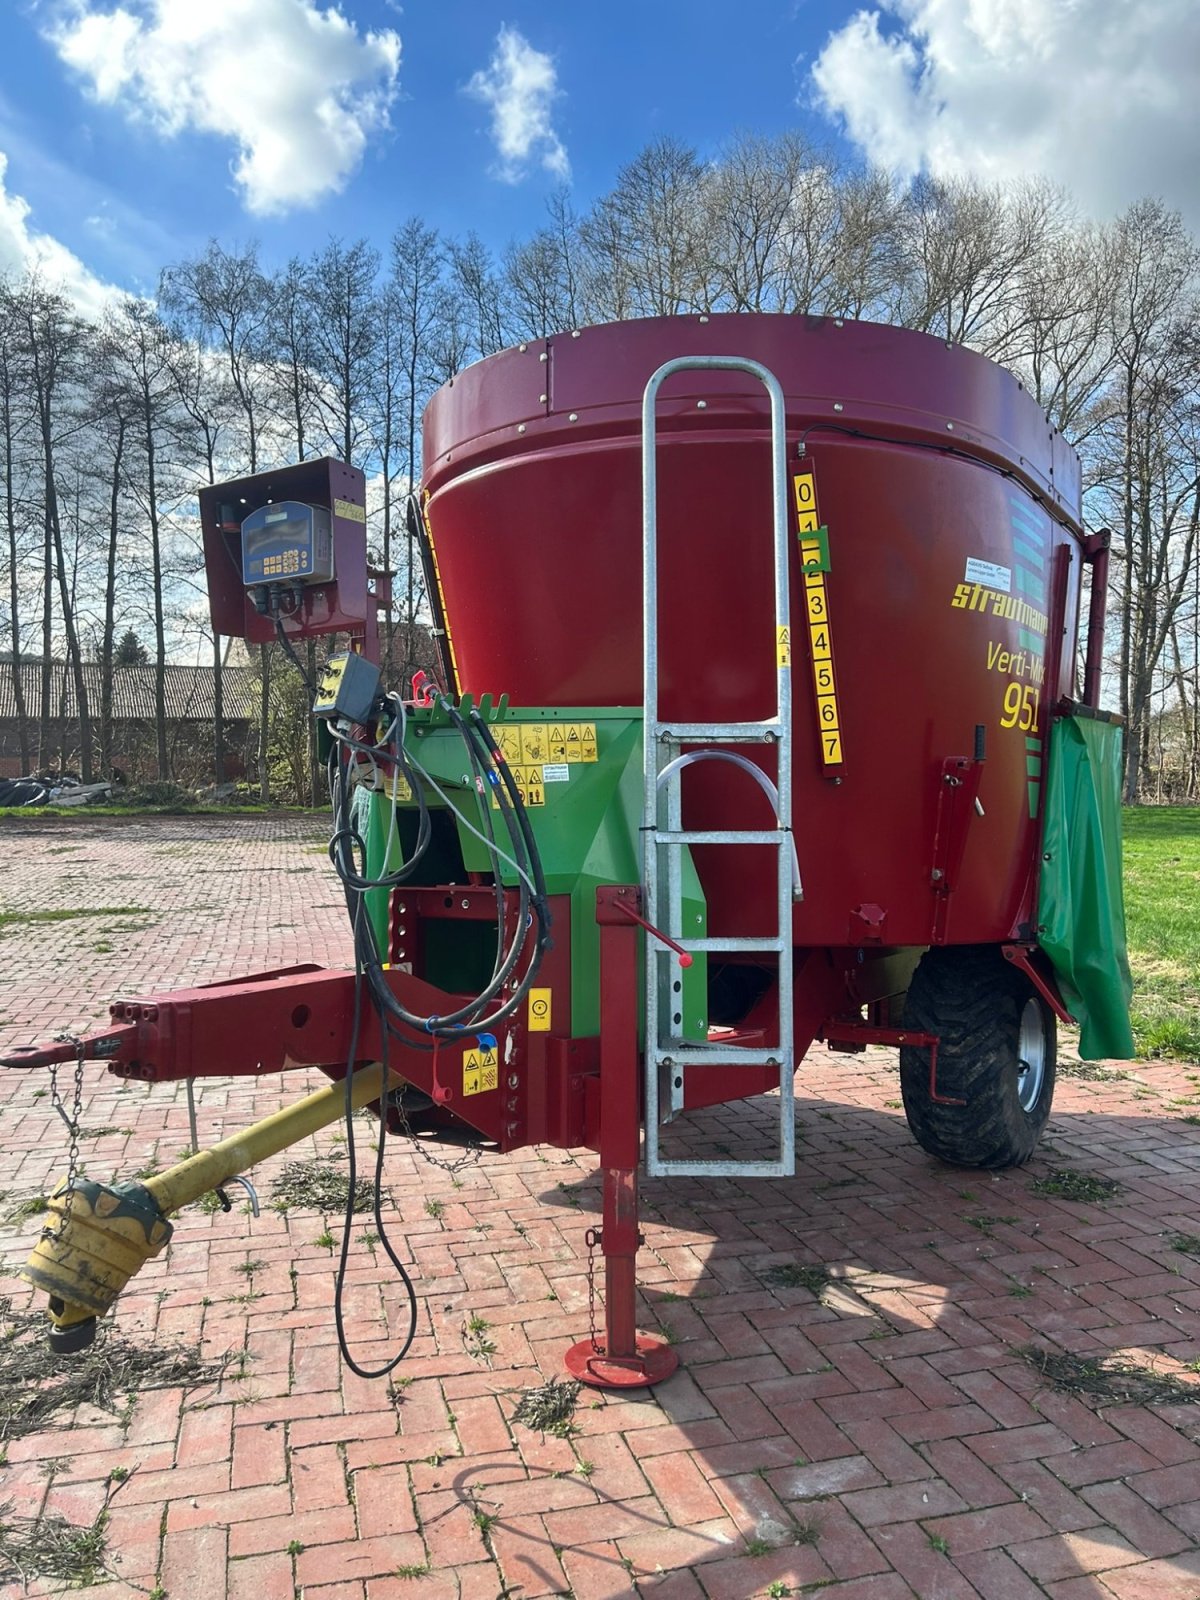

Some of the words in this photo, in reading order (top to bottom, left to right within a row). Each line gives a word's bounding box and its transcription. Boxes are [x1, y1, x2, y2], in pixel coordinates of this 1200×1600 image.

[798, 483, 812, 502] 0
[807, 558, 820, 578] 2
[810, 596, 823, 615] 3
[951, 583, 1048, 637] strautmann
[814, 632, 828, 651] 4
[986, 641, 1046, 685] Verti-Mix
[818, 668, 831, 687] 5
[821, 704, 835, 722] 6
[1000, 682, 1040, 732] 951
[825, 738, 838, 757] 7
